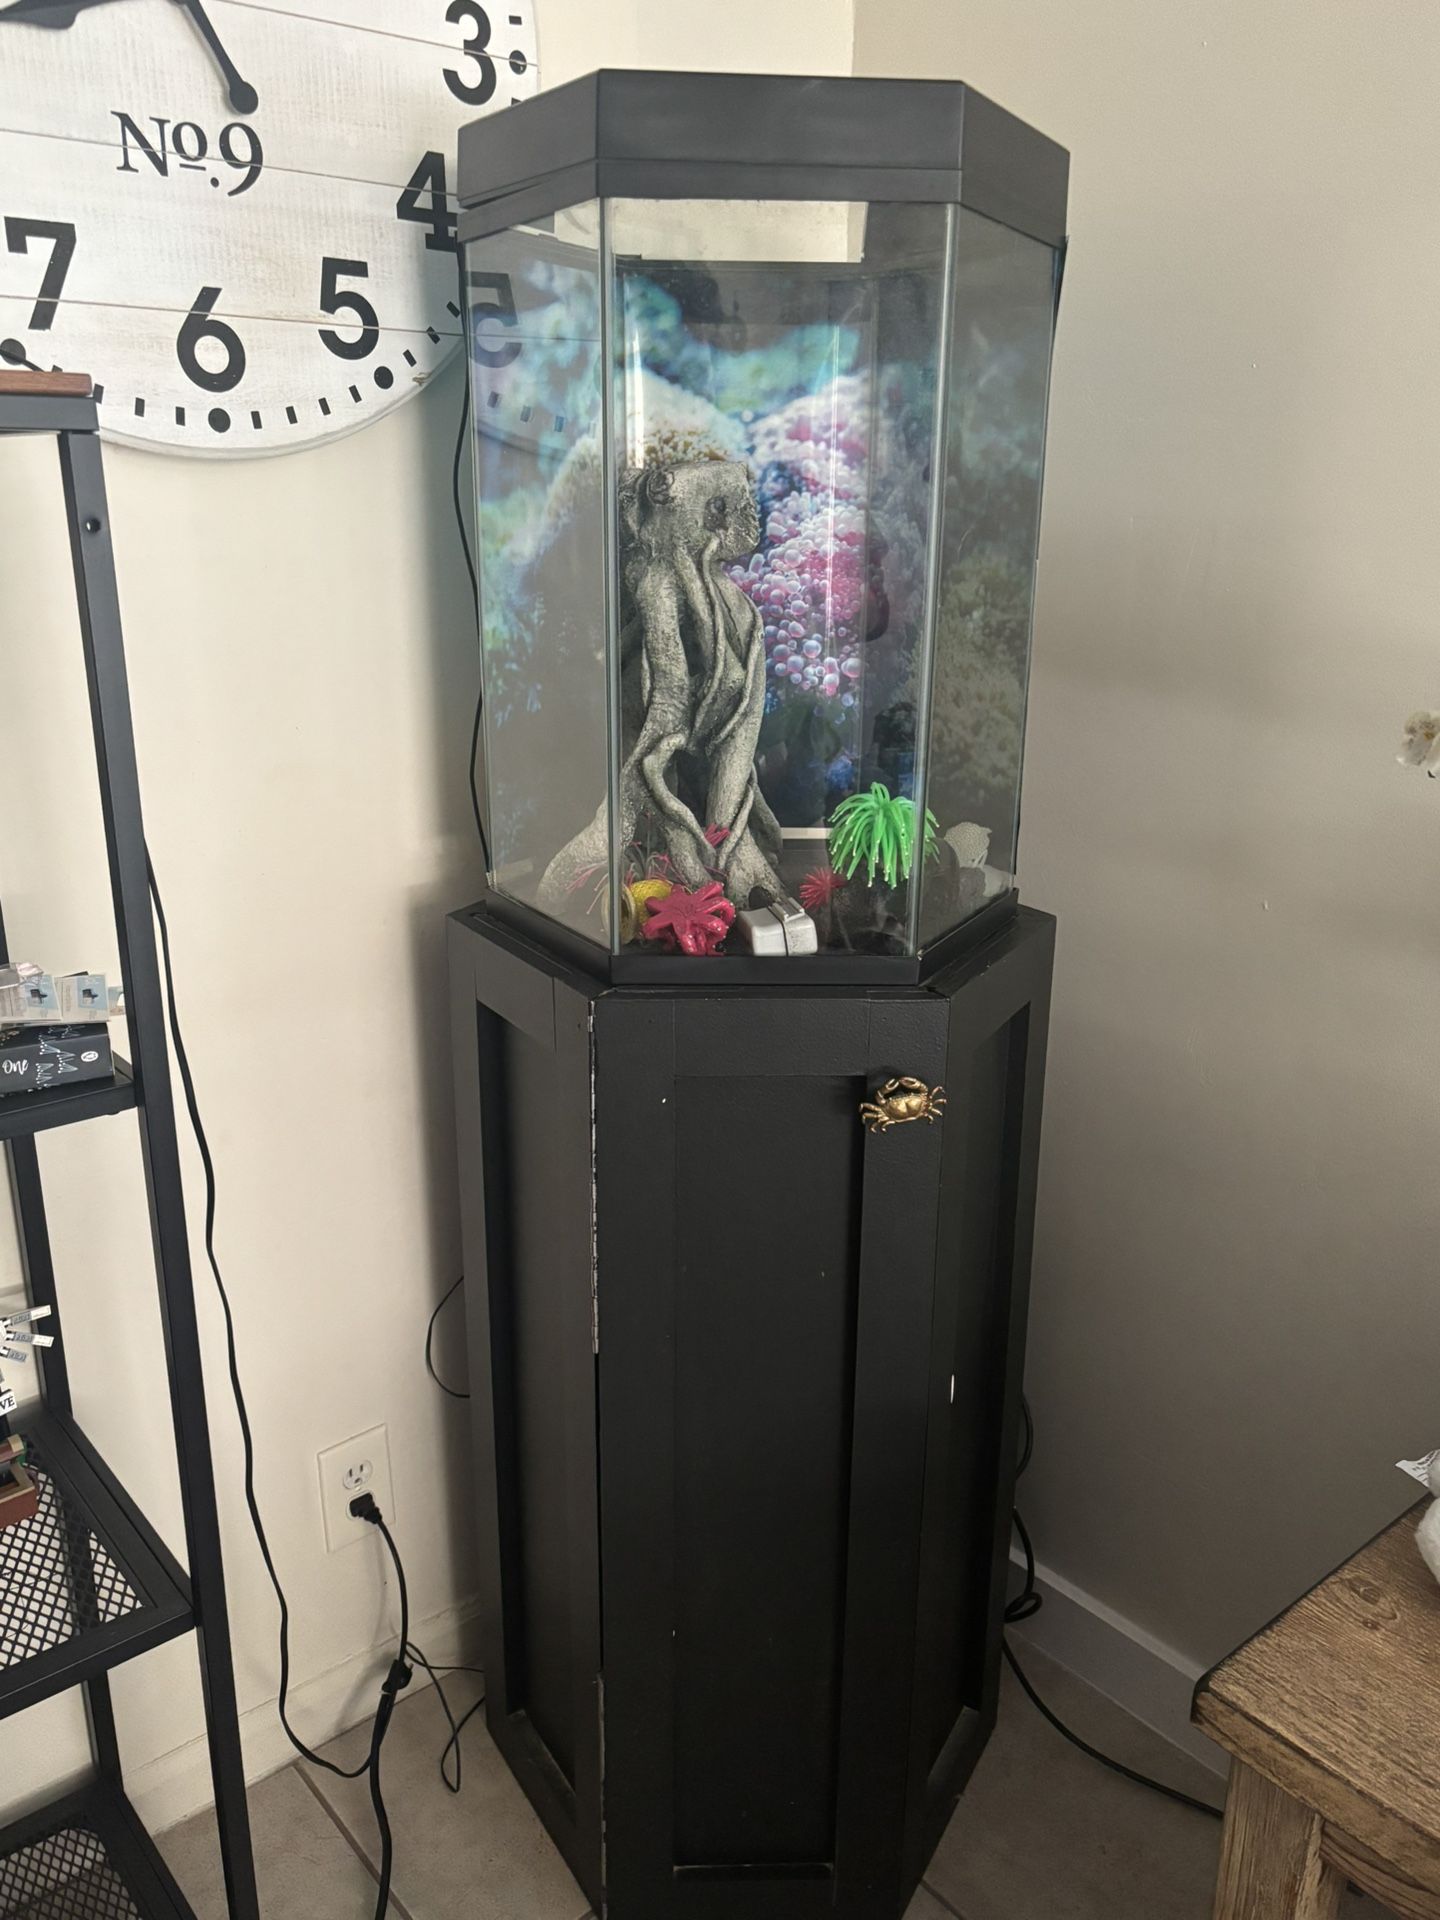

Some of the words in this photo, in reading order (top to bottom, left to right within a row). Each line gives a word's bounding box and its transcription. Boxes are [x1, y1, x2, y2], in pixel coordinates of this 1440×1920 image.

[443, 0, 497, 106] 3
[396, 150, 458, 253] 4
[4, 216, 77, 330] 7
[318, 256, 380, 360] 5
[176, 286, 246, 393] 6
